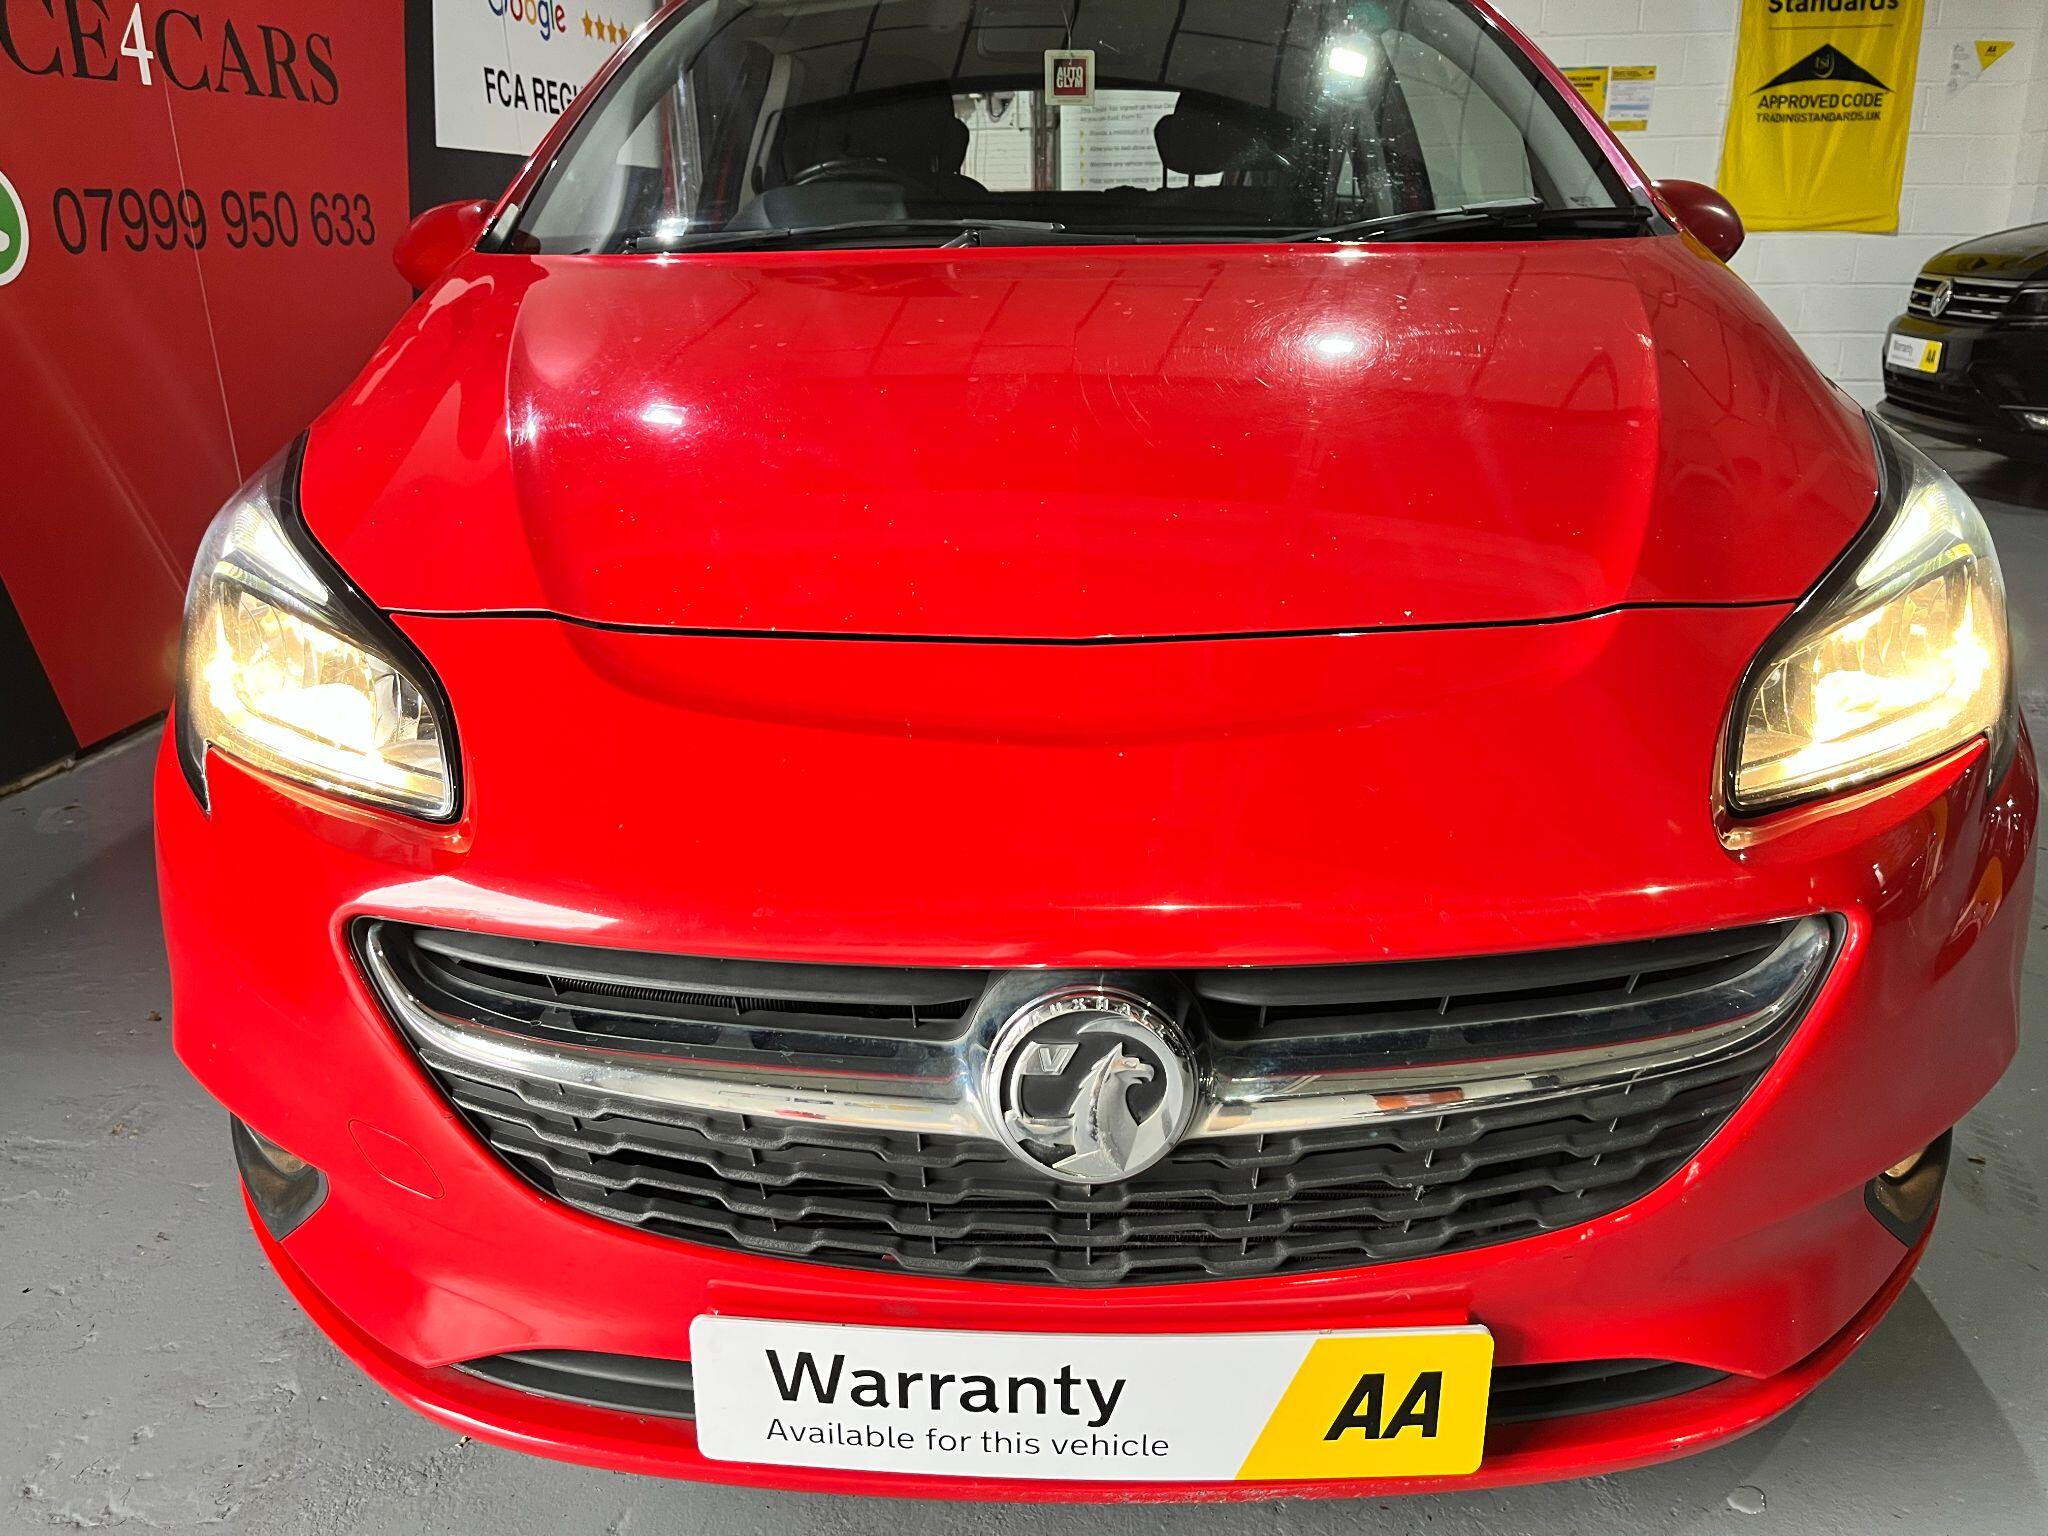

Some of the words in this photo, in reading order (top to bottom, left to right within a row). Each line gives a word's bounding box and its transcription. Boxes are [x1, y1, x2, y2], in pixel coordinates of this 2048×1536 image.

[484, 67, 528, 110] FCA
[1057, 66, 1083, 79] AUTO
[1756, 110, 1881, 123] TRADINGSTANDARDS.UK
[1757, 94, 1840, 109] APPROVED
[1842, 92, 1883, 108] CODE
[53, 187, 207, 255] 07999
[221, 189, 299, 250] 950
[310, 191, 376, 247] 633
[766, 1349, 1127, 1427] Warranty
[1324, 1372, 1442, 1440] AA
[766, 1418, 915, 1452] Available
[926, 1425, 974, 1455] for
[980, 1429, 1041, 1456] this
[1051, 1432, 1170, 1459] vehicle
